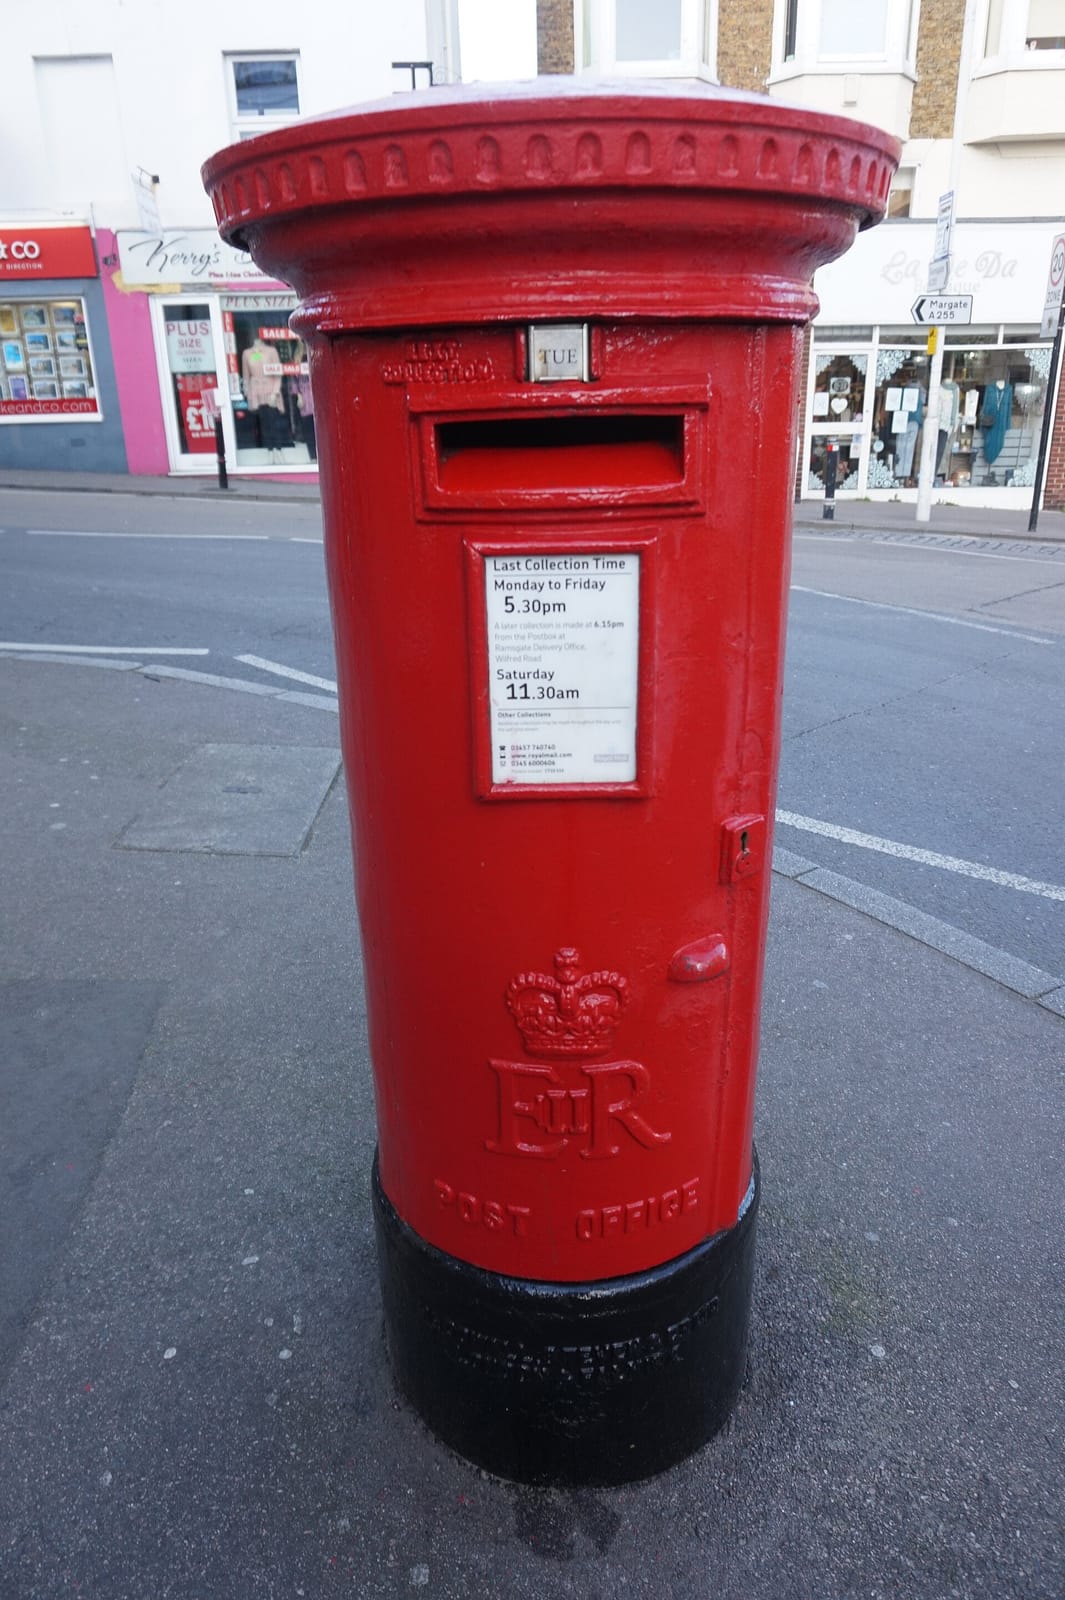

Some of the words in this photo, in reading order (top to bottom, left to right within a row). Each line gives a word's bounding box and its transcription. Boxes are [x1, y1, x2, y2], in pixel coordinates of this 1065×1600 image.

[10, 240, 41, 260] CO
[128, 236, 221, 276] Kerry's
[880, 250, 921, 285] La
[975, 250, 1018, 279] Da
[1053, 252, 1064, 273] 20
[929, 301, 968, 310] Margate
[929, 311, 955, 320] A255
[166, 321, 209, 336] PLUS
[262, 328, 286, 338] SALE
[178, 338, 202, 348] SIZE
[539, 349, 578, 364] TUE
[493, 560, 521, 571] Last
[525, 558, 589, 571] Collection
[593, 557, 626, 570] Time
[494, 580, 545, 593] Monday
[548, 580, 561, 590] to
[565, 578, 606, 592] Friday
[504, 596, 566, 615] 5.30pm
[594, 620, 625, 629] 6.15pm
[495, 644, 532, 653] Ramsgate
[496, 669, 555, 681] Saturday
[506, 683, 580, 700] 11.30am
[434, 1178, 531, 1237] POST
[575, 1176, 700, 1240] OFFICE
